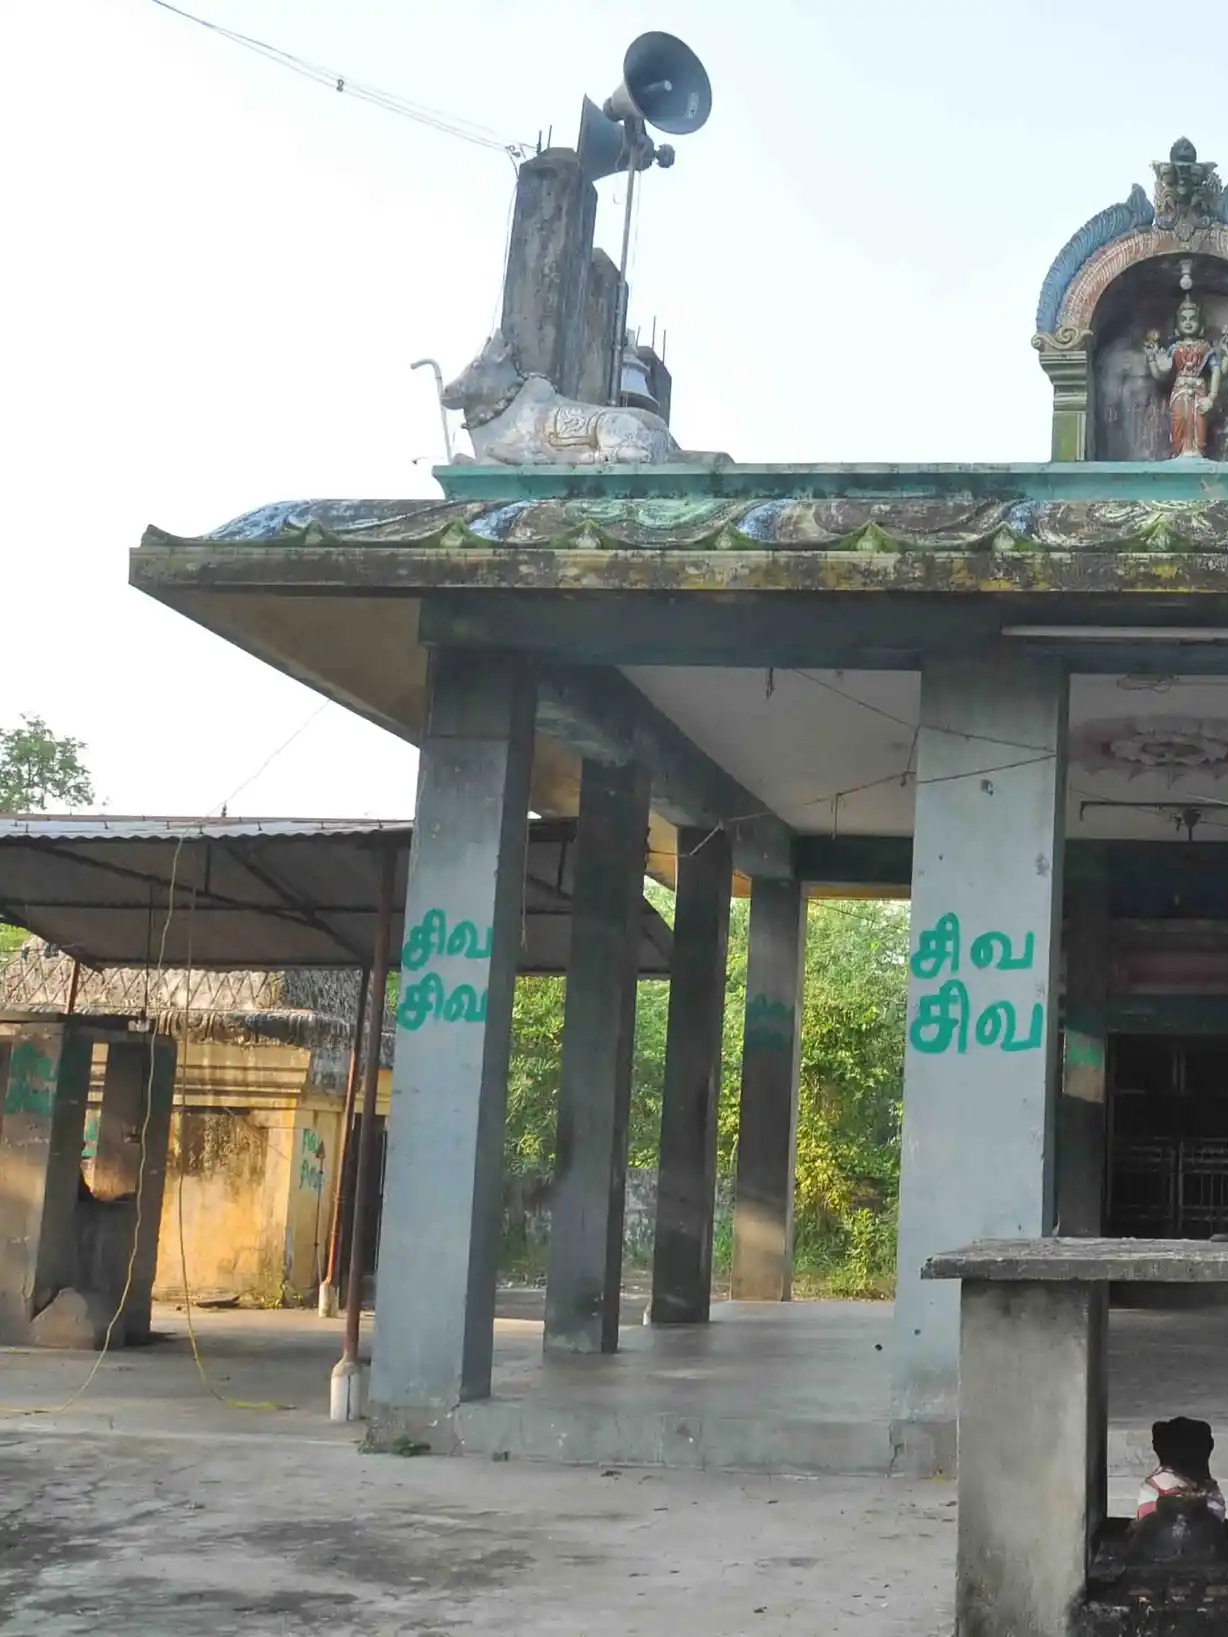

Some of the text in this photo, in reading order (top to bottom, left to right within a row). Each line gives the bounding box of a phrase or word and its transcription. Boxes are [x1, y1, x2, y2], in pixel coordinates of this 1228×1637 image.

[402, 907, 493, 971] சிவ
[911, 912, 1035, 980] சிவ
[396, 972, 488, 1032] சிவ
[910, 979, 1044, 1055] சிவ
